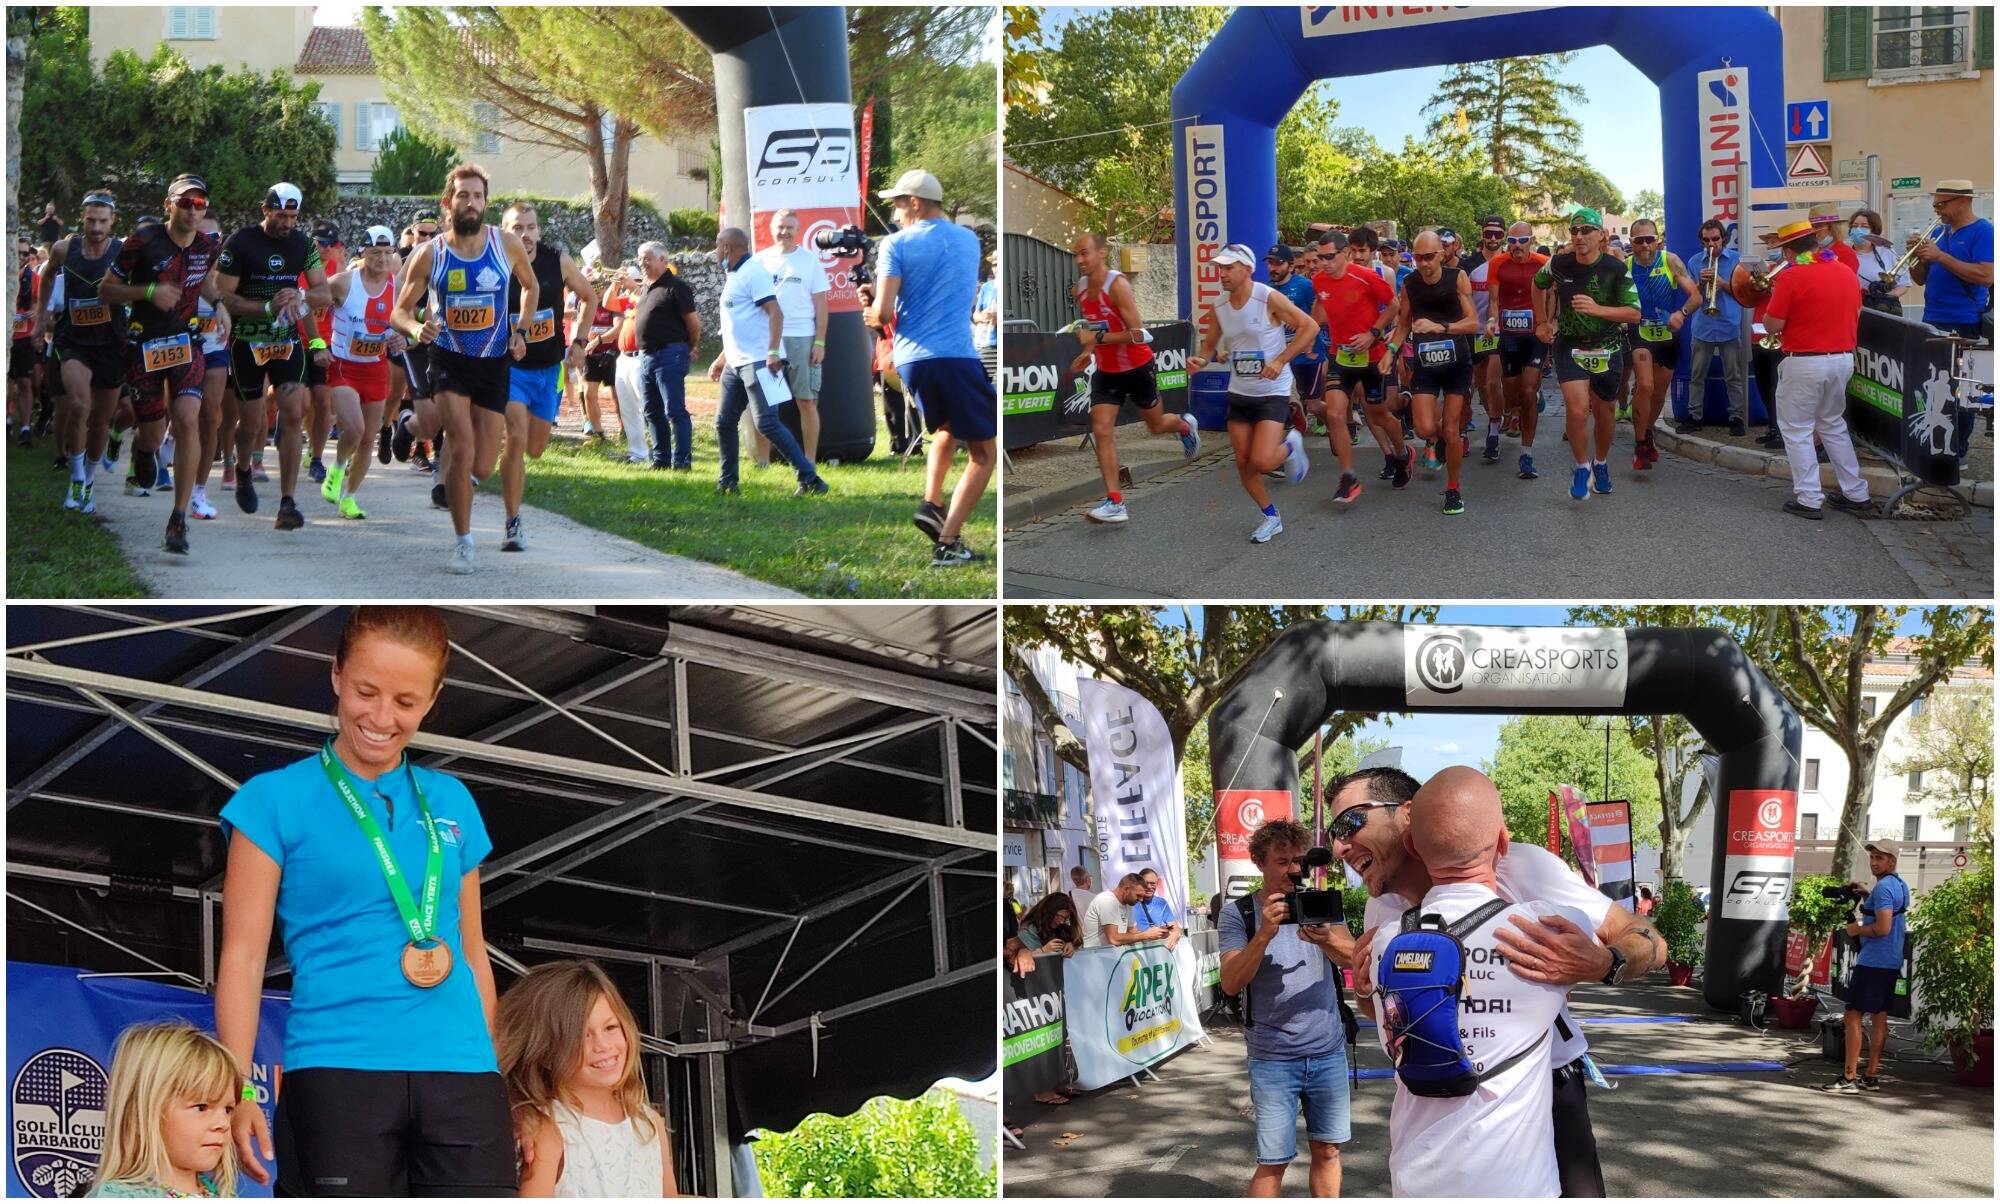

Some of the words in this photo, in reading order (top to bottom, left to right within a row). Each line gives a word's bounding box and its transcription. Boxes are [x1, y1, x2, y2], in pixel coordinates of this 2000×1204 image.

[757, 175, 847, 187] CONSULT
[452, 308, 487, 324] 2027
[1506, 317, 1529, 328] 4098
[1648, 327, 1663, 337] 15
[152, 346, 185, 365] 2153
[1425, 350, 1451, 363] 4002
[1583, 357, 1600, 369] 39
[1018, 396, 1052, 410] VERTE
[1471, 648, 1619, 670] CREASPORTS
[1471, 672, 1572, 685] ORGANISATION
[1732, 830, 1794, 843] CREASPORTS
[1394, 952, 1432, 969] CAMELBAK
[1469, 969, 1496, 981] LUC
[1123, 962, 1175, 1013] APEX
[1473, 1026, 1496, 1039] Fils
[16, 1119, 57, 1134] GOLF
[18, 1133, 104, 1150] BARBAROU
